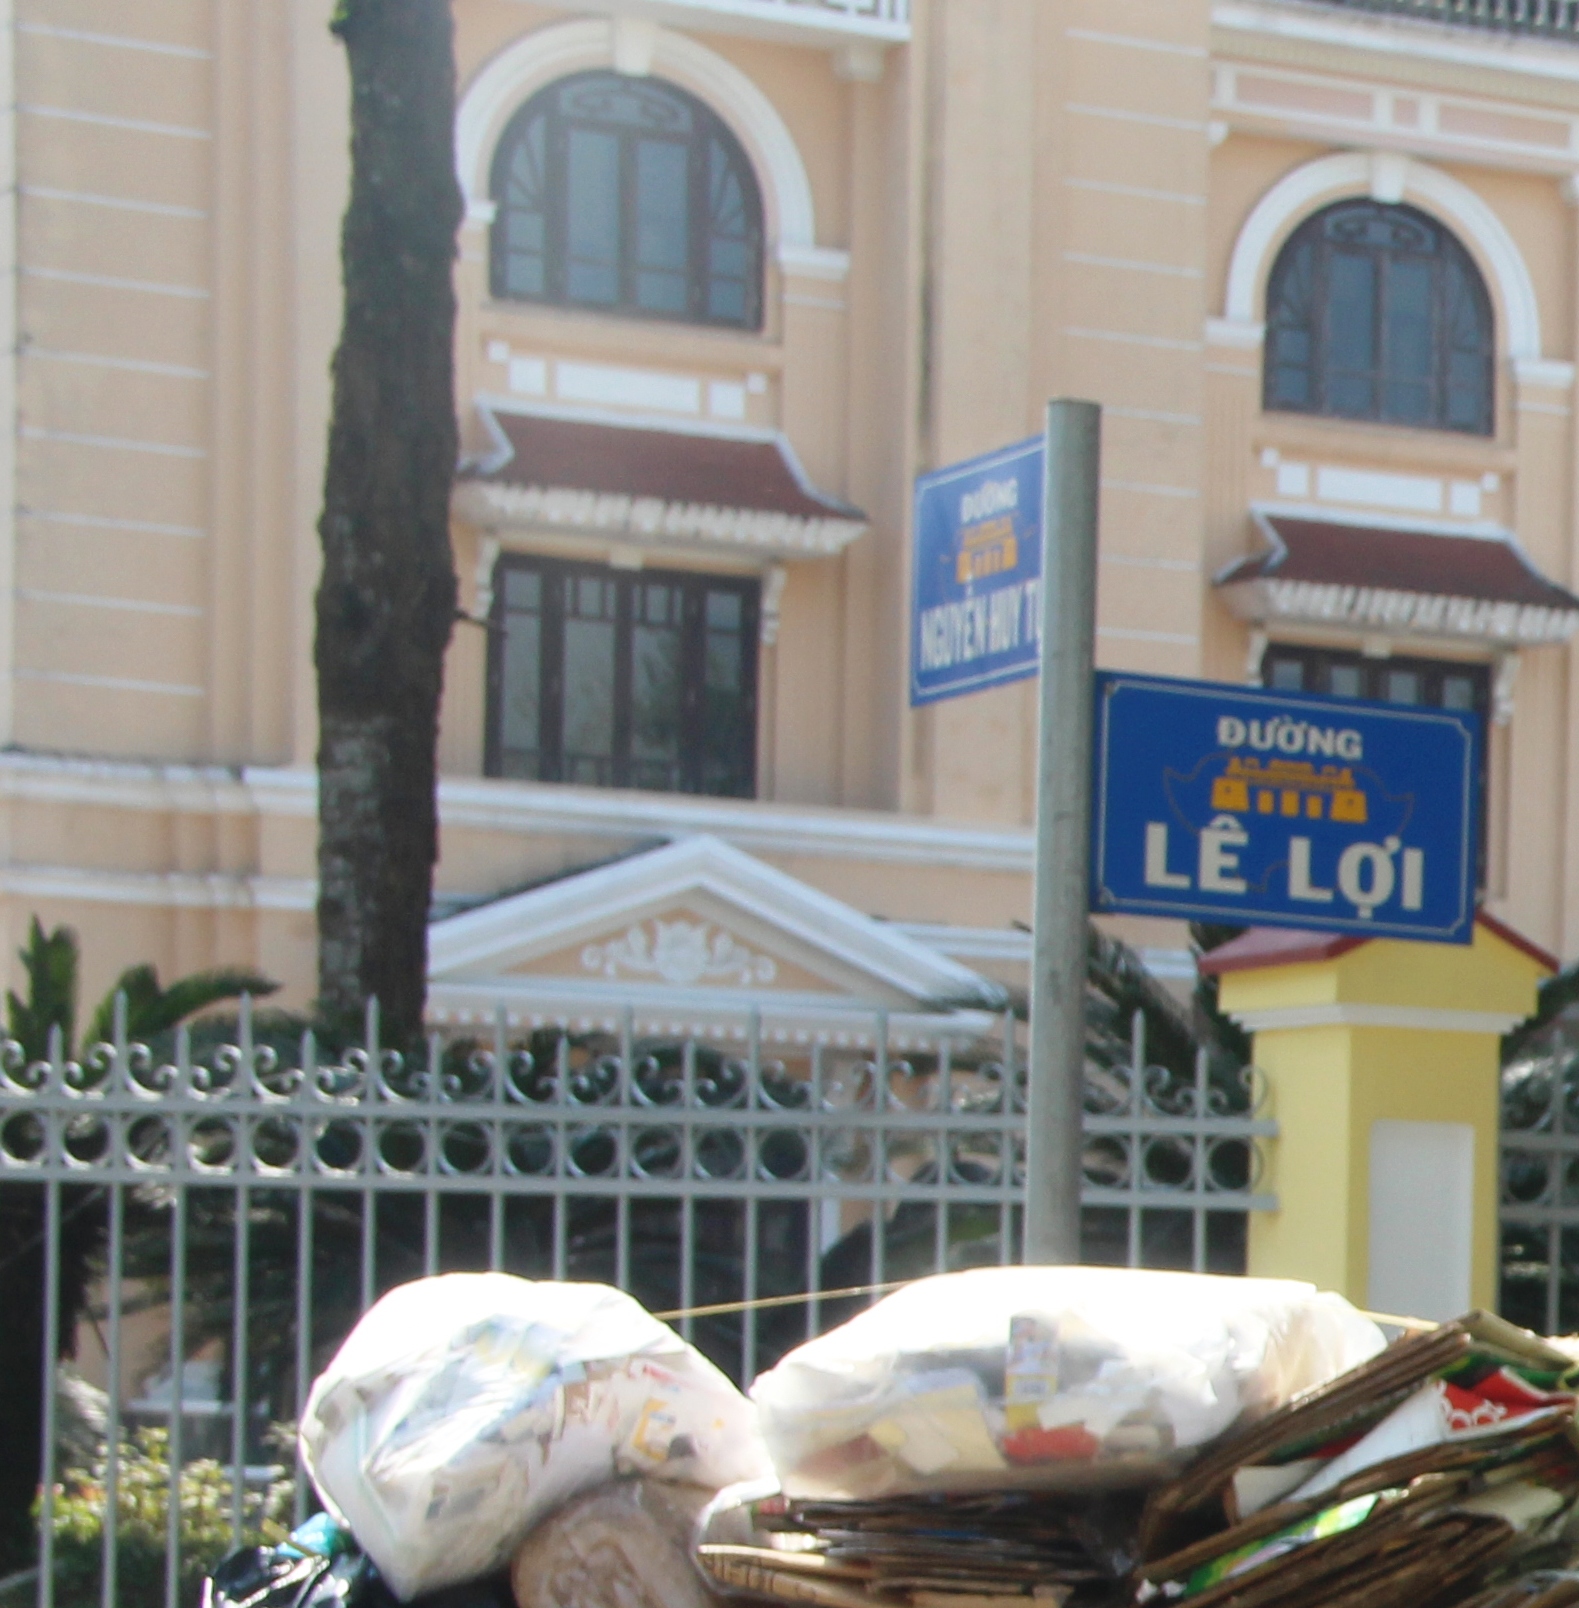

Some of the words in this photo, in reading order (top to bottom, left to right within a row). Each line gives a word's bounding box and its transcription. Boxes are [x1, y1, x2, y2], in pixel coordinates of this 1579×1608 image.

[1216, 715, 1363, 760] ĐƯỜNG
[1144, 813, 1250, 895] LÊ
[1287, 835, 1424, 919] LỢI
